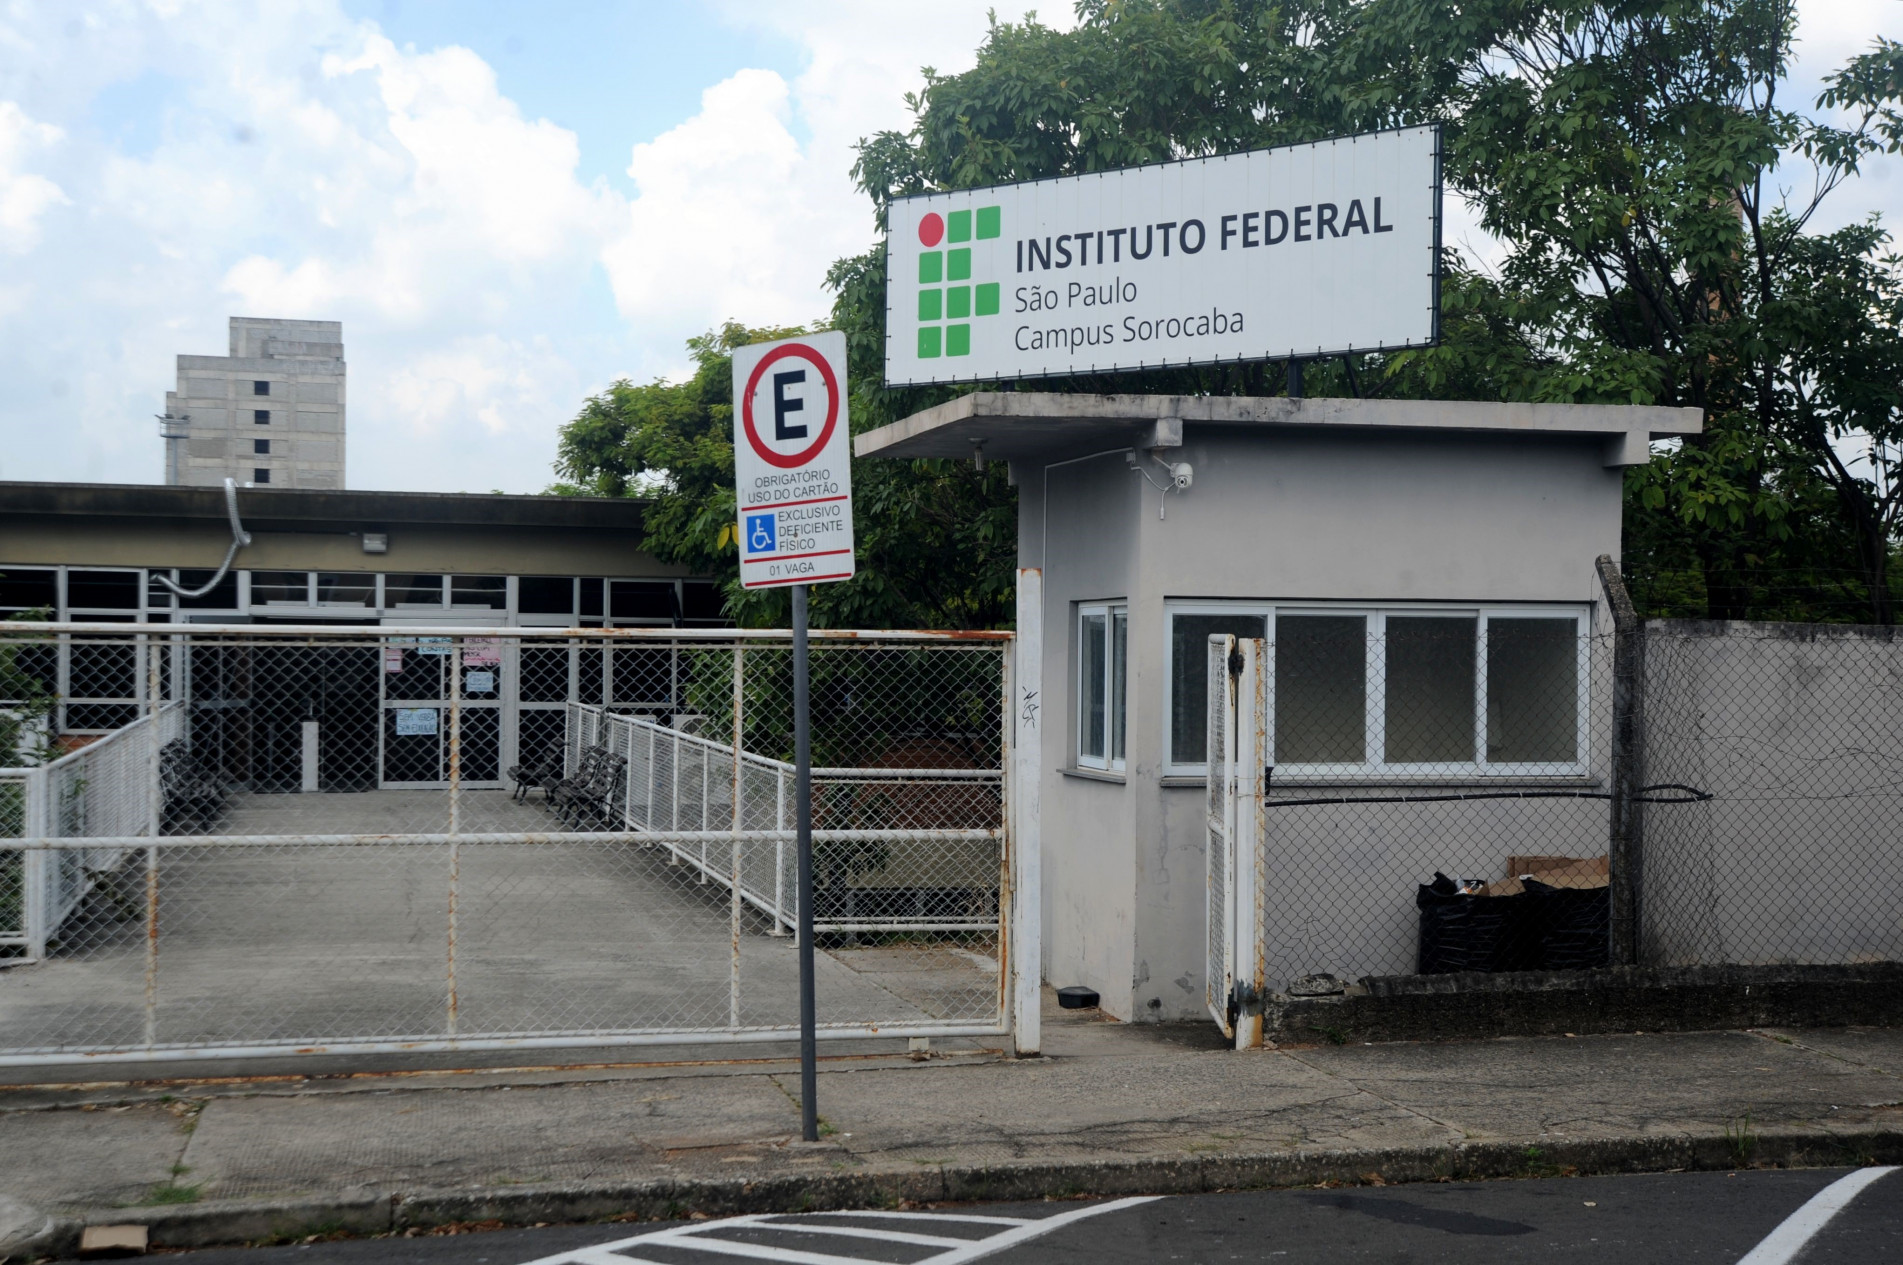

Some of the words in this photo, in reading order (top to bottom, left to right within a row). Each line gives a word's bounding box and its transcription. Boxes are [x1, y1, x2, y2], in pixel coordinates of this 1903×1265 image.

[1016, 218, 1206, 274] INSTITUTO
[1220, 196, 1394, 251] FEDERAL
[1014, 285, 1058, 313] São
[1068, 276, 1138, 310] Paulo
[1014, 324, 1114, 356] Campus
[1122, 307, 1244, 343] Sorocaba
[773, 369, 808, 441] E
[754, 469, 831, 489] OBRIGATÓRIO
[748, 491, 772, 504] USO
[774, 488, 791, 501] DO
[793, 481, 839, 499] CARTÃO
[778, 505, 841, 522] EXCLUSIVO
[778, 520, 844, 537] DEFICIENTE
[779, 538, 816, 552] FÍSICO
[769, 565, 780, 576] 01
[784, 562, 815, 575] VAGA
